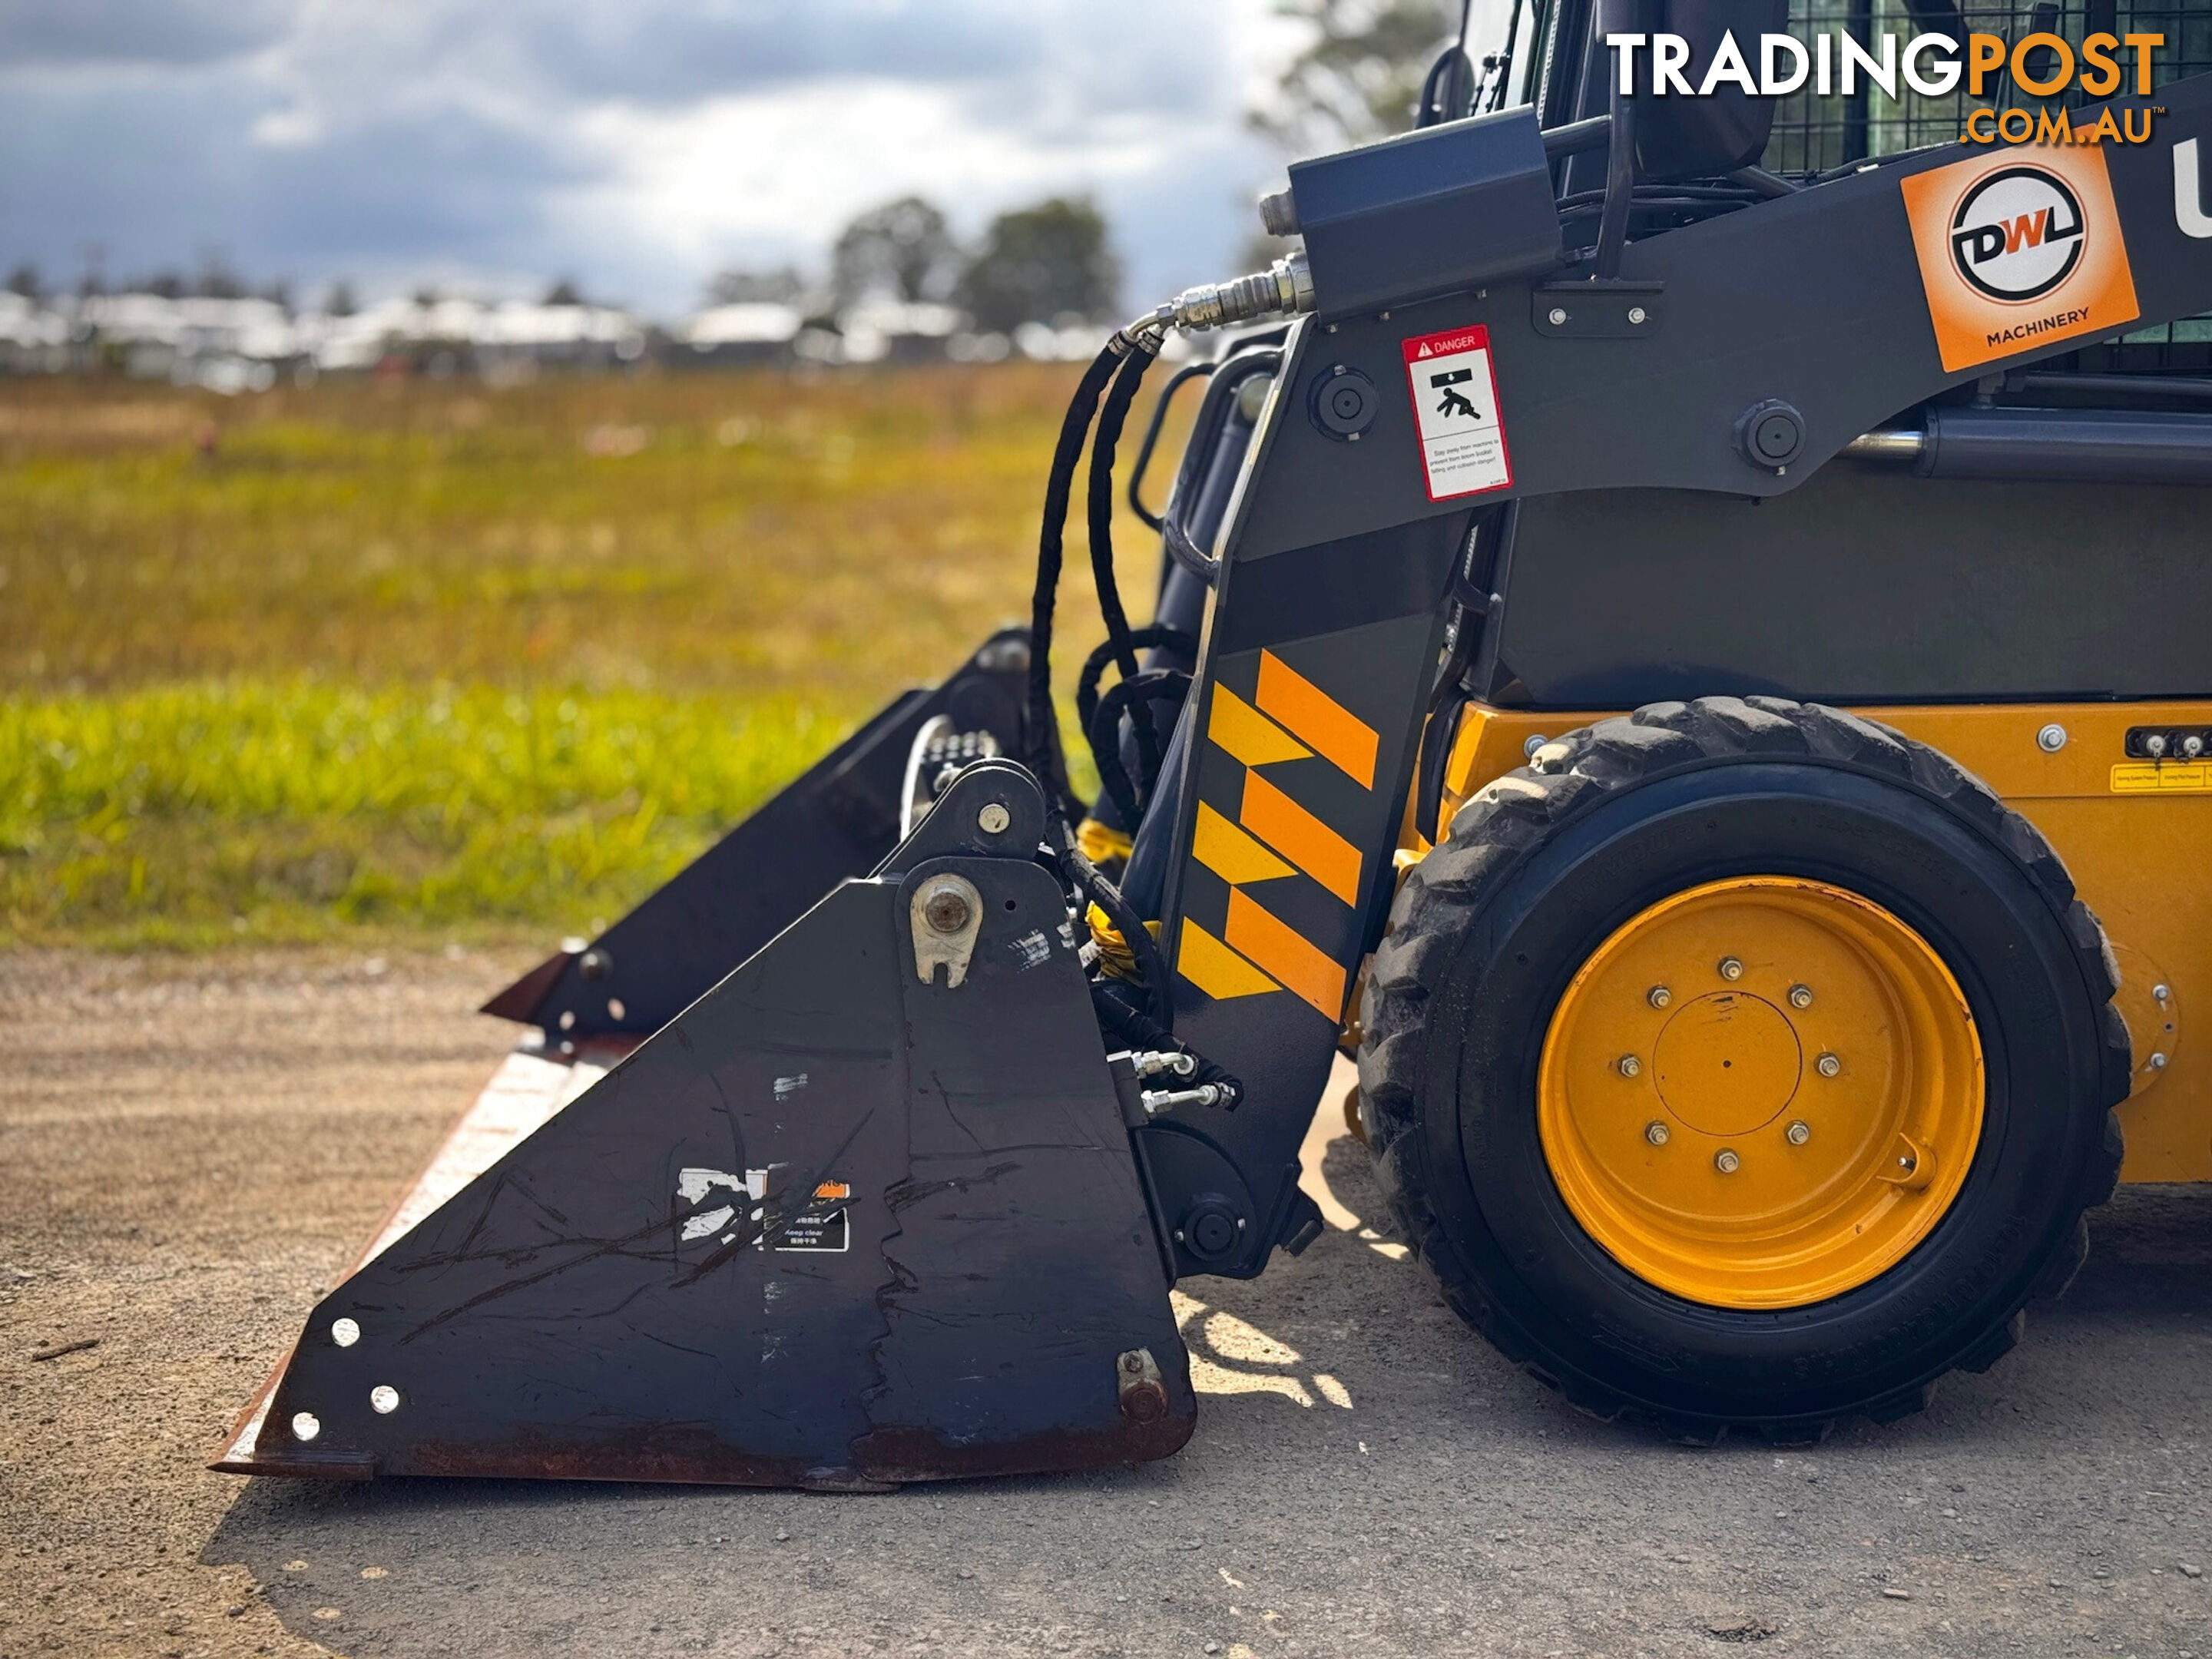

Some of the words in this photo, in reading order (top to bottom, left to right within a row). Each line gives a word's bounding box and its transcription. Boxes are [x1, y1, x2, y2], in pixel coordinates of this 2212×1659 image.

[1959, 206, 2082, 265] DWL
[1434, 336, 1475, 353] DANGER
[1986, 306, 2089, 347] MACHINERY
